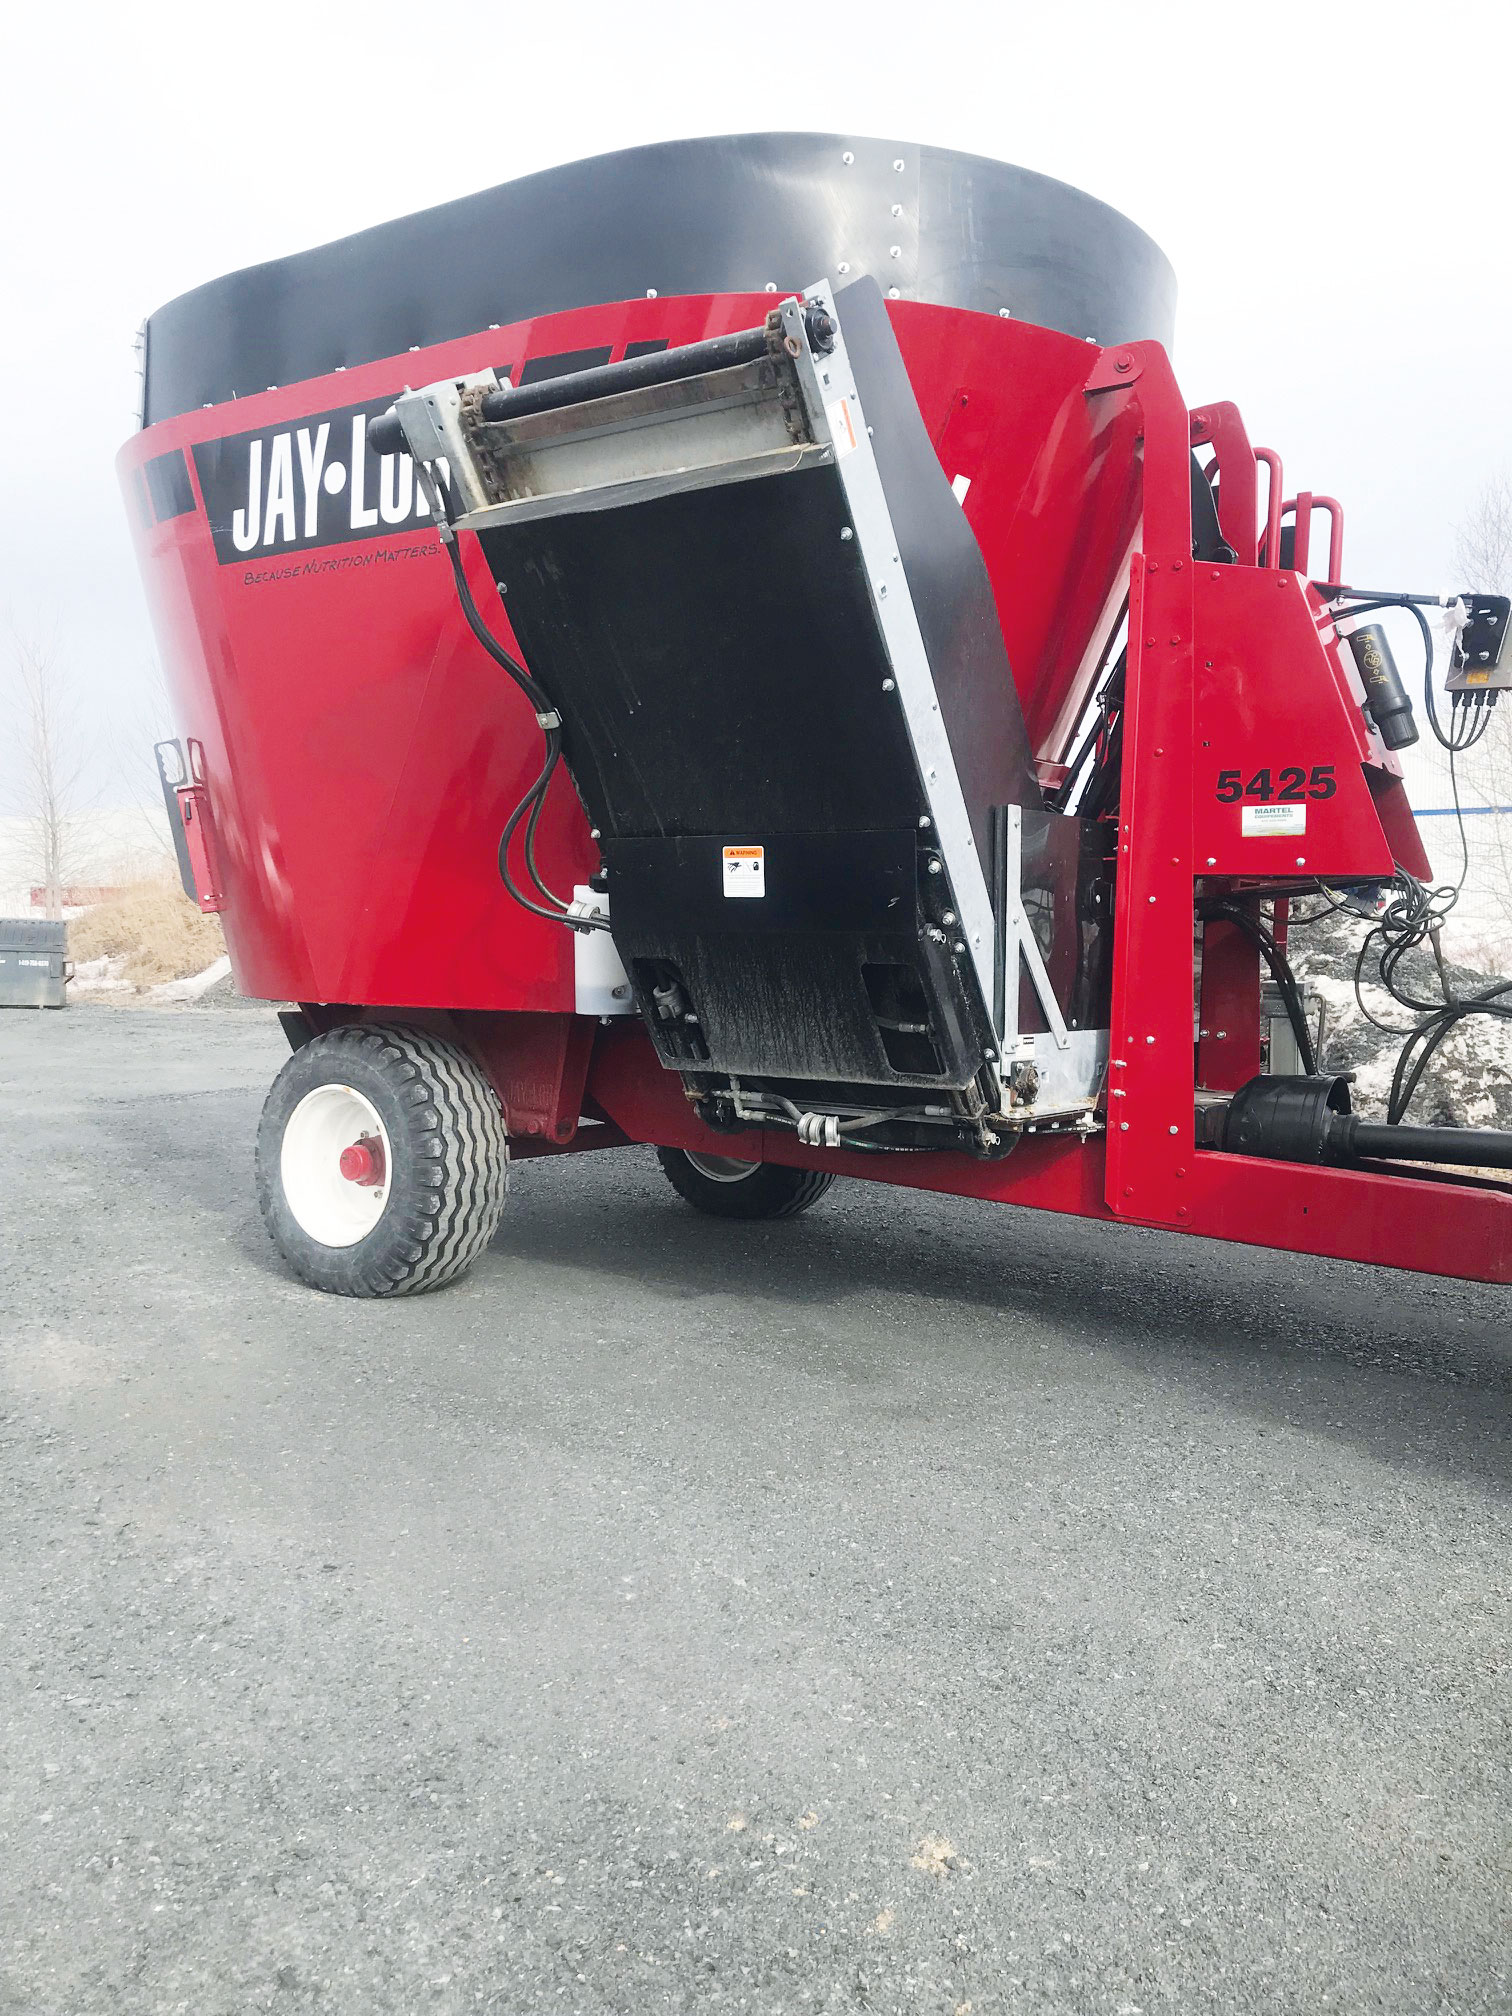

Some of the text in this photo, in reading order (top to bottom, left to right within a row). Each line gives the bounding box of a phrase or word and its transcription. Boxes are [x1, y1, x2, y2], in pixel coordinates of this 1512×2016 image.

[244, 565, 301, 586] BECAUSE
[302, 554, 373, 576] NUTRITION
[1216, 766, 1337, 803] 5425
[1254, 807, 1294, 815] MARTEL
